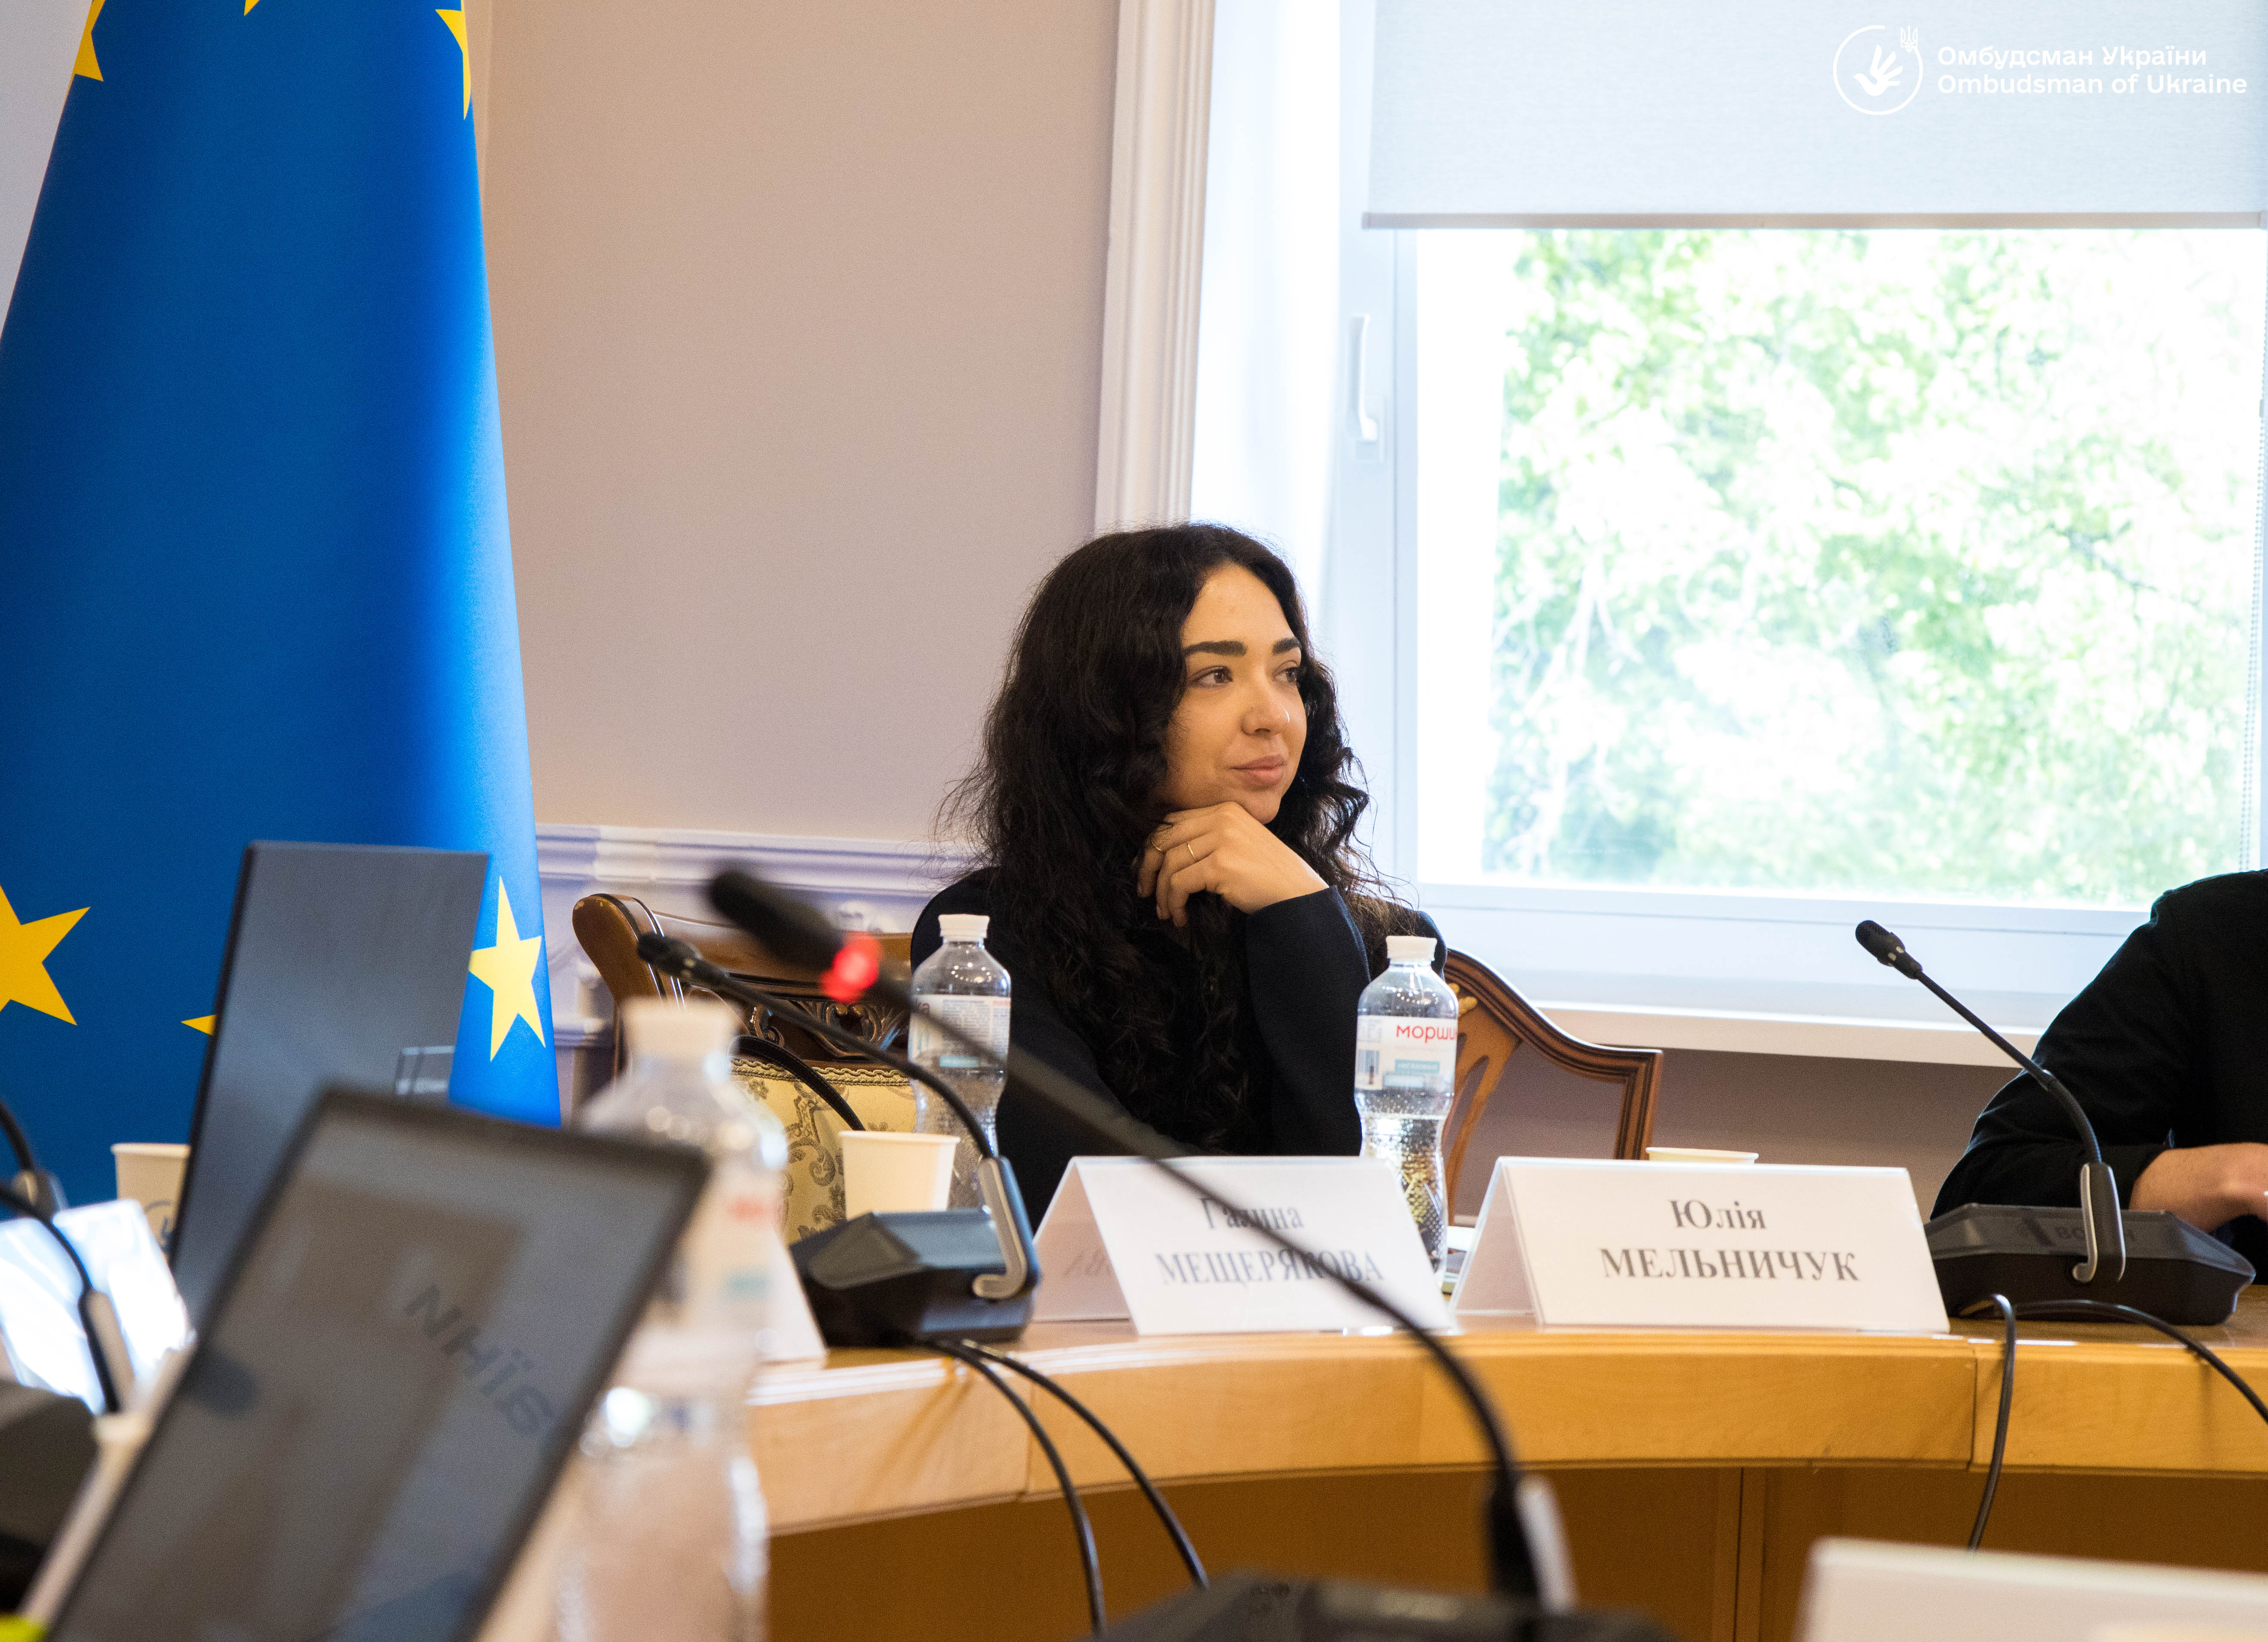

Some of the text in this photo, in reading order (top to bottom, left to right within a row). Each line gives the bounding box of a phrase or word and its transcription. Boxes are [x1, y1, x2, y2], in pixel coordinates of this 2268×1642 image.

[1669, 1200, 1766, 1229] Юлія
[1155, 1250, 1385, 1286] МЕЩЕРЯКОВА
[1599, 1248, 1860, 1282] МЕЛЬНИЧУК
